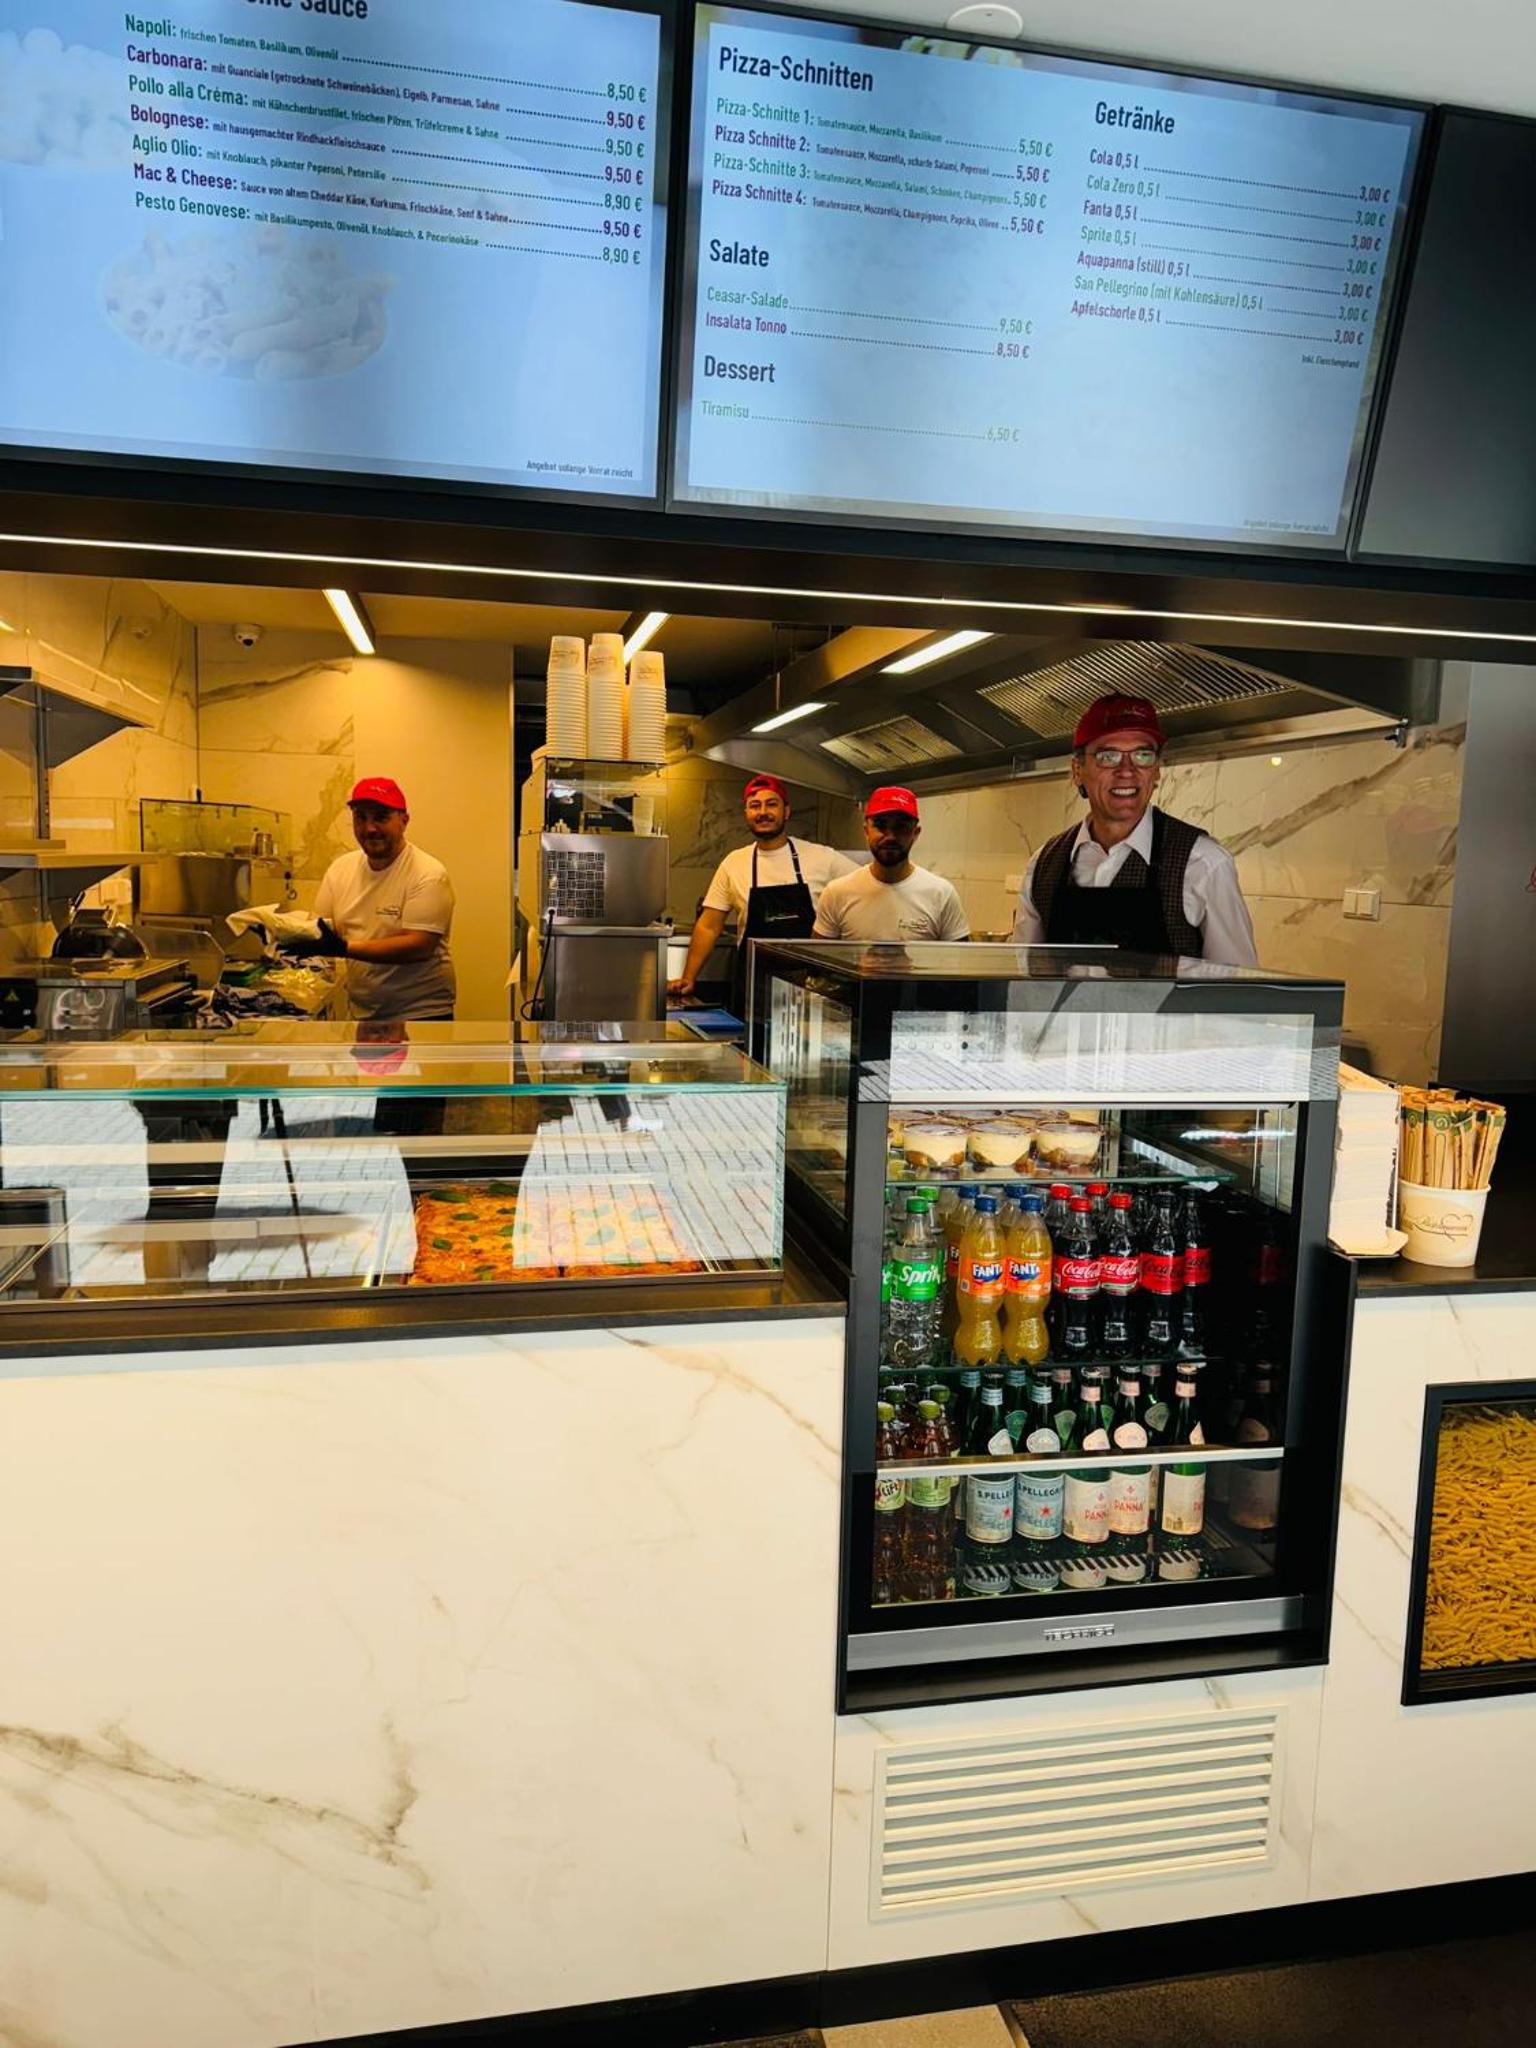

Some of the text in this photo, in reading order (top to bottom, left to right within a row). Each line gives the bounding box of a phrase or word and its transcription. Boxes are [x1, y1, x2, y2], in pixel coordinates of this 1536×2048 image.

[125, 14, 176, 38] Napoli:
[607, 83, 634, 101] 8,50
[638, 87, 647, 103] €
[719, 46, 874, 92] Pizza-Schnitten
[127, 44, 207, 71] Carbonara:
[211, 63, 226, 74] mit
[606, 110, 633, 129] 9,50
[637, 115, 646, 131] €
[129, 74, 164, 95] Pollo
[168, 81, 194, 99] alla
[252, 98, 266, 108] mit
[605, 138, 632, 156] 9,50
[636, 142, 645, 158] €
[716, 97, 1053, 158] Pizza-Schnitte 1: 5,50 €
[1095, 101, 1175, 135] Getränke
[130, 104, 209, 129] Bolognese:
[212, 121, 227, 132] mit
[229, 123, 294, 141] hausgemachter
[605, 165, 632, 184] 9,50
[636, 170, 644, 186] €
[715, 124, 1050, 184] Pizza Schnitte 2: 5,50 €
[132, 134, 167, 155] Aglio
[171, 138, 202, 158] Olio:
[206, 149, 220, 160] mit
[270, 156, 304, 170] pikanter
[604, 193, 631, 211] 8,90
[635, 197, 643, 212] €
[714, 152, 1047, 209] Pizza-Schnitte 3: 5,50 €
[1089, 148, 1113, 166] Cola
[1115, 152, 1132, 169] 0,5
[1359, 185, 1381, 202] 3,00
[1383, 189, 1391, 203] €
[134, 162, 162, 181] Mac
[166, 167, 177, 183] &
[181, 168, 237, 190] Cheese:
[240, 181, 266, 194] Sauce
[268, 187, 283, 196] von
[476, 210, 483, 220] &
[603, 220, 630, 237] 9,50
[634, 223, 642, 238] €
[712, 179, 742, 198] Pizza
[745, 183, 793, 204] Schnitte
[795, 189, 807, 206] 4:
[1011, 216, 1035, 234] 5,50
[1037, 219, 1045, 235] €
[1084, 199, 1112, 218] Fanta
[1114, 203, 1131, 220] 0,5
[1351, 235, 1372, 252] 3,00
[1087, 175, 1110, 192] Cola
[1111, 178, 1135, 195] Zero
[1136, 181, 1154, 198] 0,5
[1355, 210, 1377, 227] 3,00
[136, 191, 175, 211] Pesto
[179, 196, 250, 219] Genovese:
[254, 212, 268, 222] mit
[417, 230, 424, 240] &
[602, 246, 629, 264] 8,90
[633, 250, 641, 265] €
[709, 238, 769, 268] Salate
[1081, 225, 1112, 244] Sprite
[1114, 229, 1131, 247] 0,5
[1346, 259, 1368, 275] 3,00
[1074, 275, 1093, 291] San
[1096, 277, 1149, 298] Pellegrino
[1150, 283, 1171, 301] (mit
[1174, 288, 1240, 309] Kohlensäure)
[1242, 295, 1258, 311] 0,5
[1338, 306, 1360, 322] 3,00
[1077, 250, 1134, 271] Aquapanna
[1136, 256, 1165, 275] (still)
[1167, 261, 1184, 277] 0,5
[1342, 282, 1364, 299] 3,00
[706, 312, 1030, 359] Insalata Tonno 8,50 €
[707, 286, 1033, 336] Ceasar-Salade 9,50 €
[1071, 299, 1136, 319] Apfelschorle
[1138, 306, 1155, 323] 0,5
[1333, 329, 1355, 346] 3,00
[704, 355, 776, 383] Dessert
[701, 400, 749, 420] Tiramisu
[986, 427, 1010, 442] 6,50
